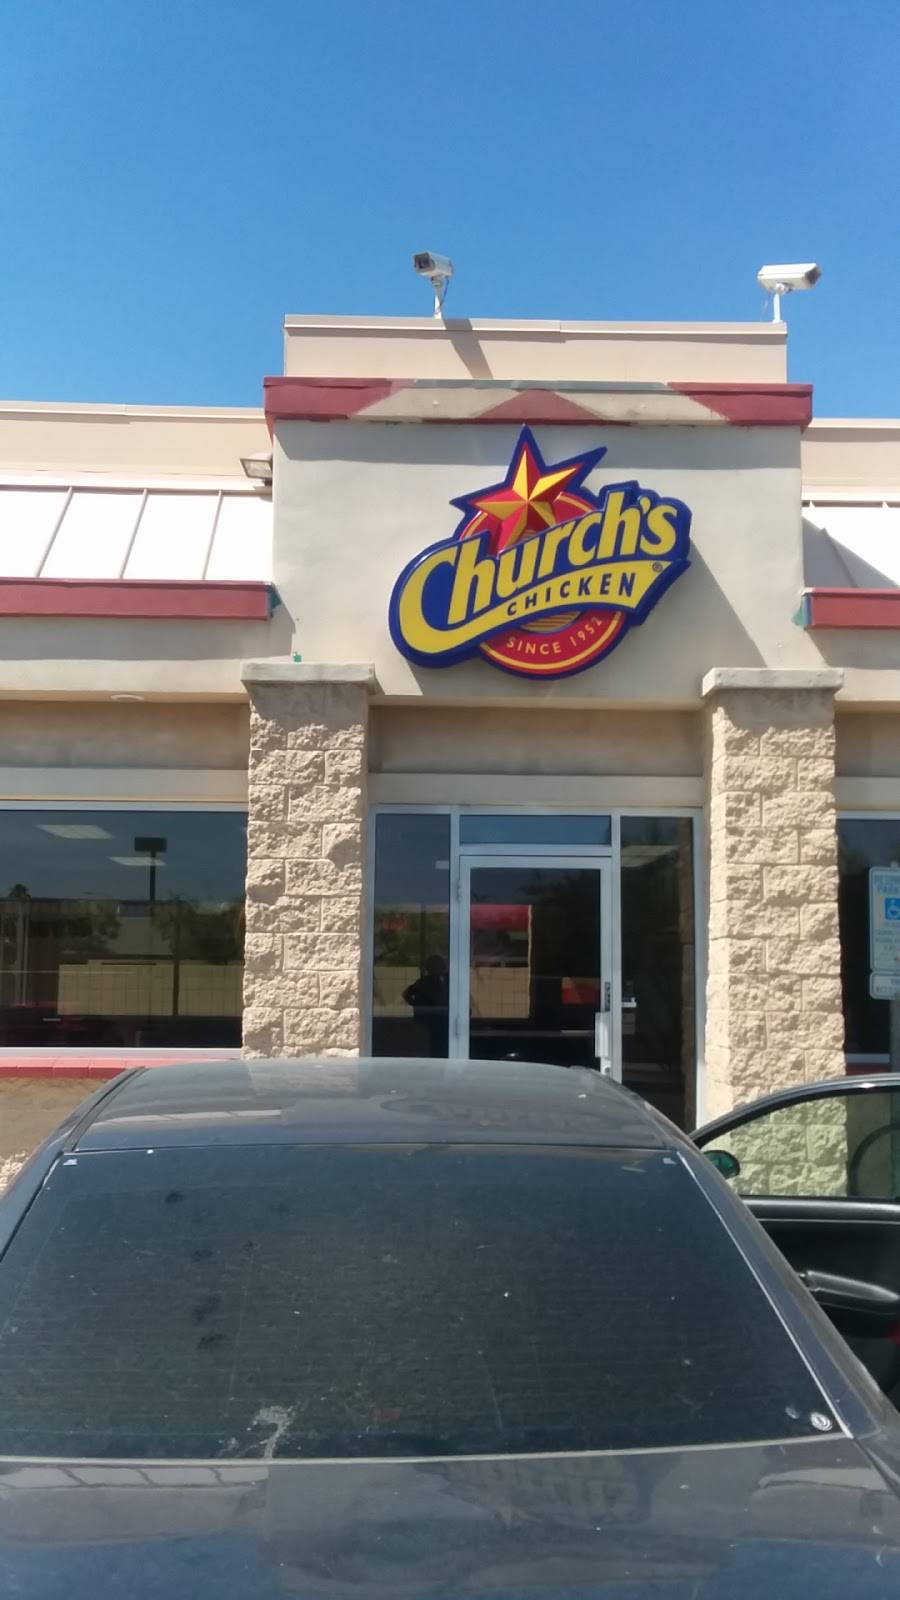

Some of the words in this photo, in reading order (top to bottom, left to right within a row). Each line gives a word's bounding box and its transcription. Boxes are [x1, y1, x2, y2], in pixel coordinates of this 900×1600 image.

[399, 490, 679, 654] Church's
[507, 572, 636, 616] CHICKEN
[506, 636, 562, 655] SINCE
[570, 617, 603, 647] 1952
